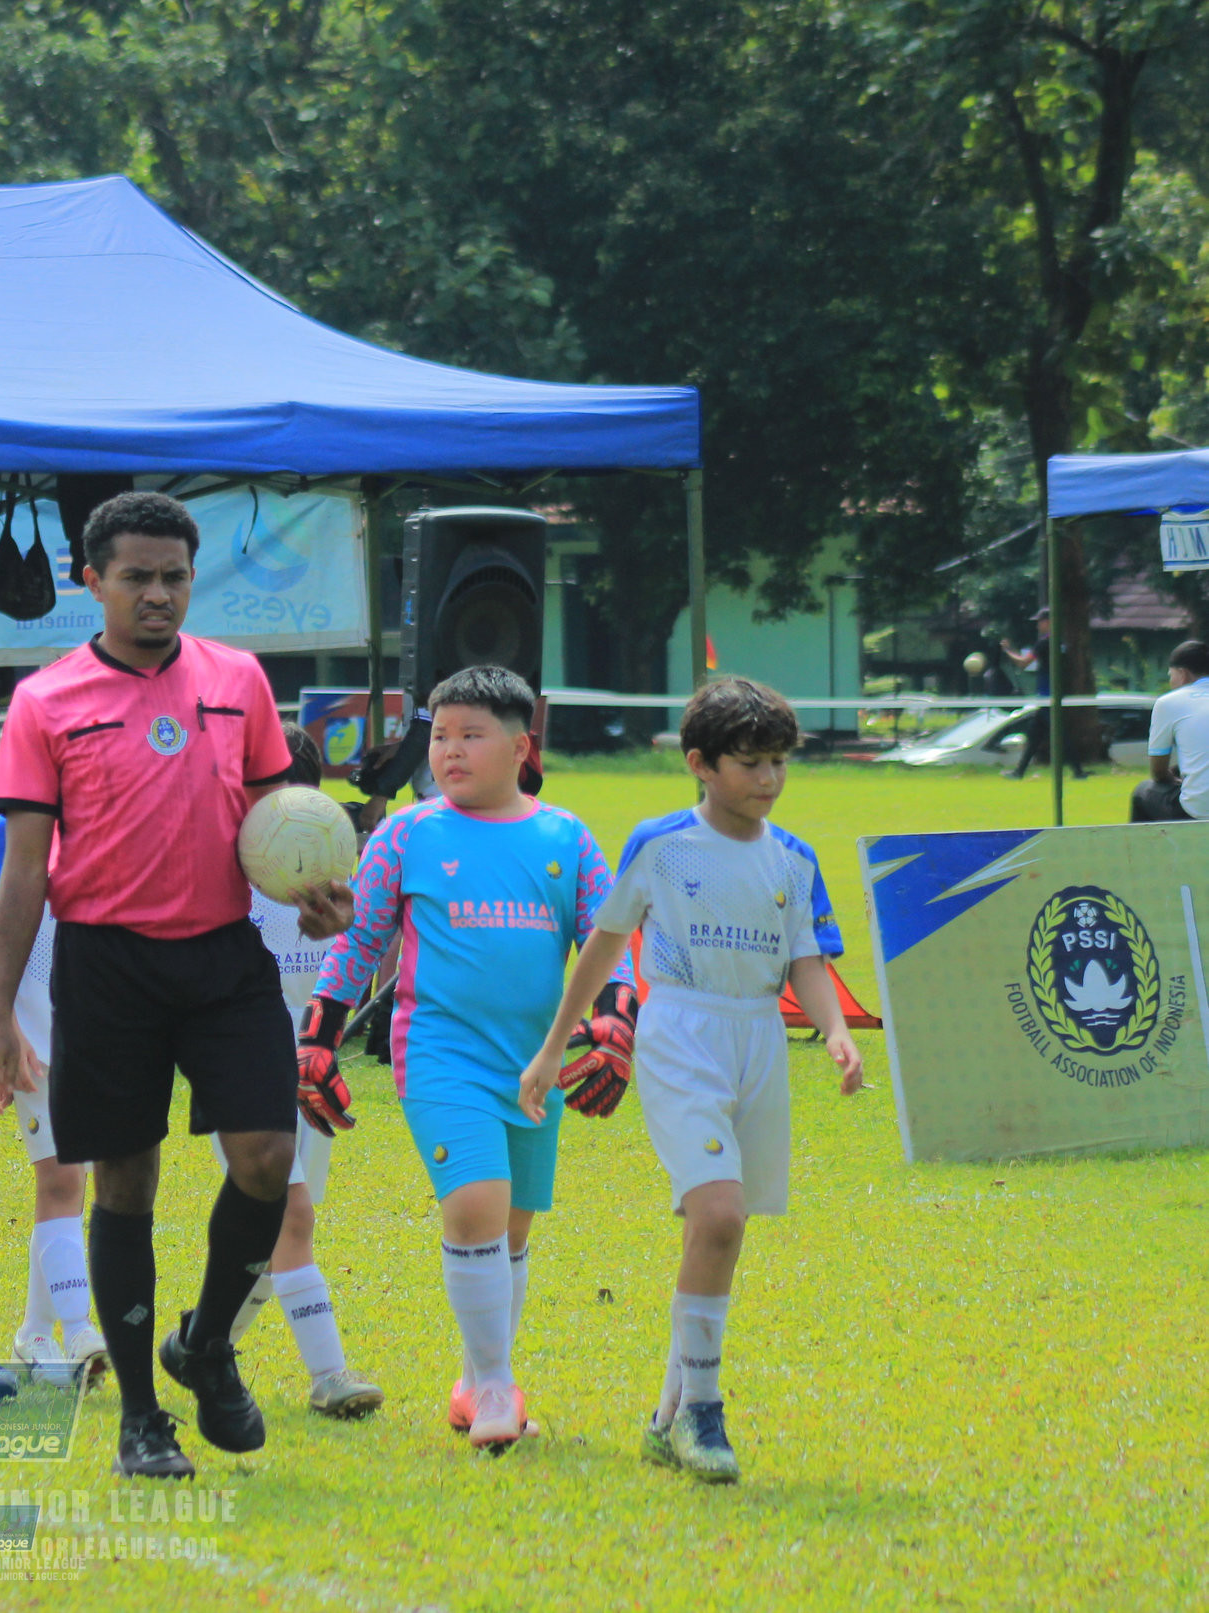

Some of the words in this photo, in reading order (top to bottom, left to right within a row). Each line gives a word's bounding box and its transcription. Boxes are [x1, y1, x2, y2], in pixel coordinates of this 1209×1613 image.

[450, 917, 505, 928] SOCCER
[690, 923, 781, 944] BRAZILIAN
[1062, 930, 1116, 952] PSSI
[690, 938, 732, 949] SOCCER
[734, 941, 779, 955] SCHOOLS
[1004, 981, 1048, 1059] FOOTBALL
[1051, 1053, 1140, 1088] ASSOCIATION
[1139, 1052, 1159, 1073] OF
[1153, 974, 1186, 1056] INDONESIA
